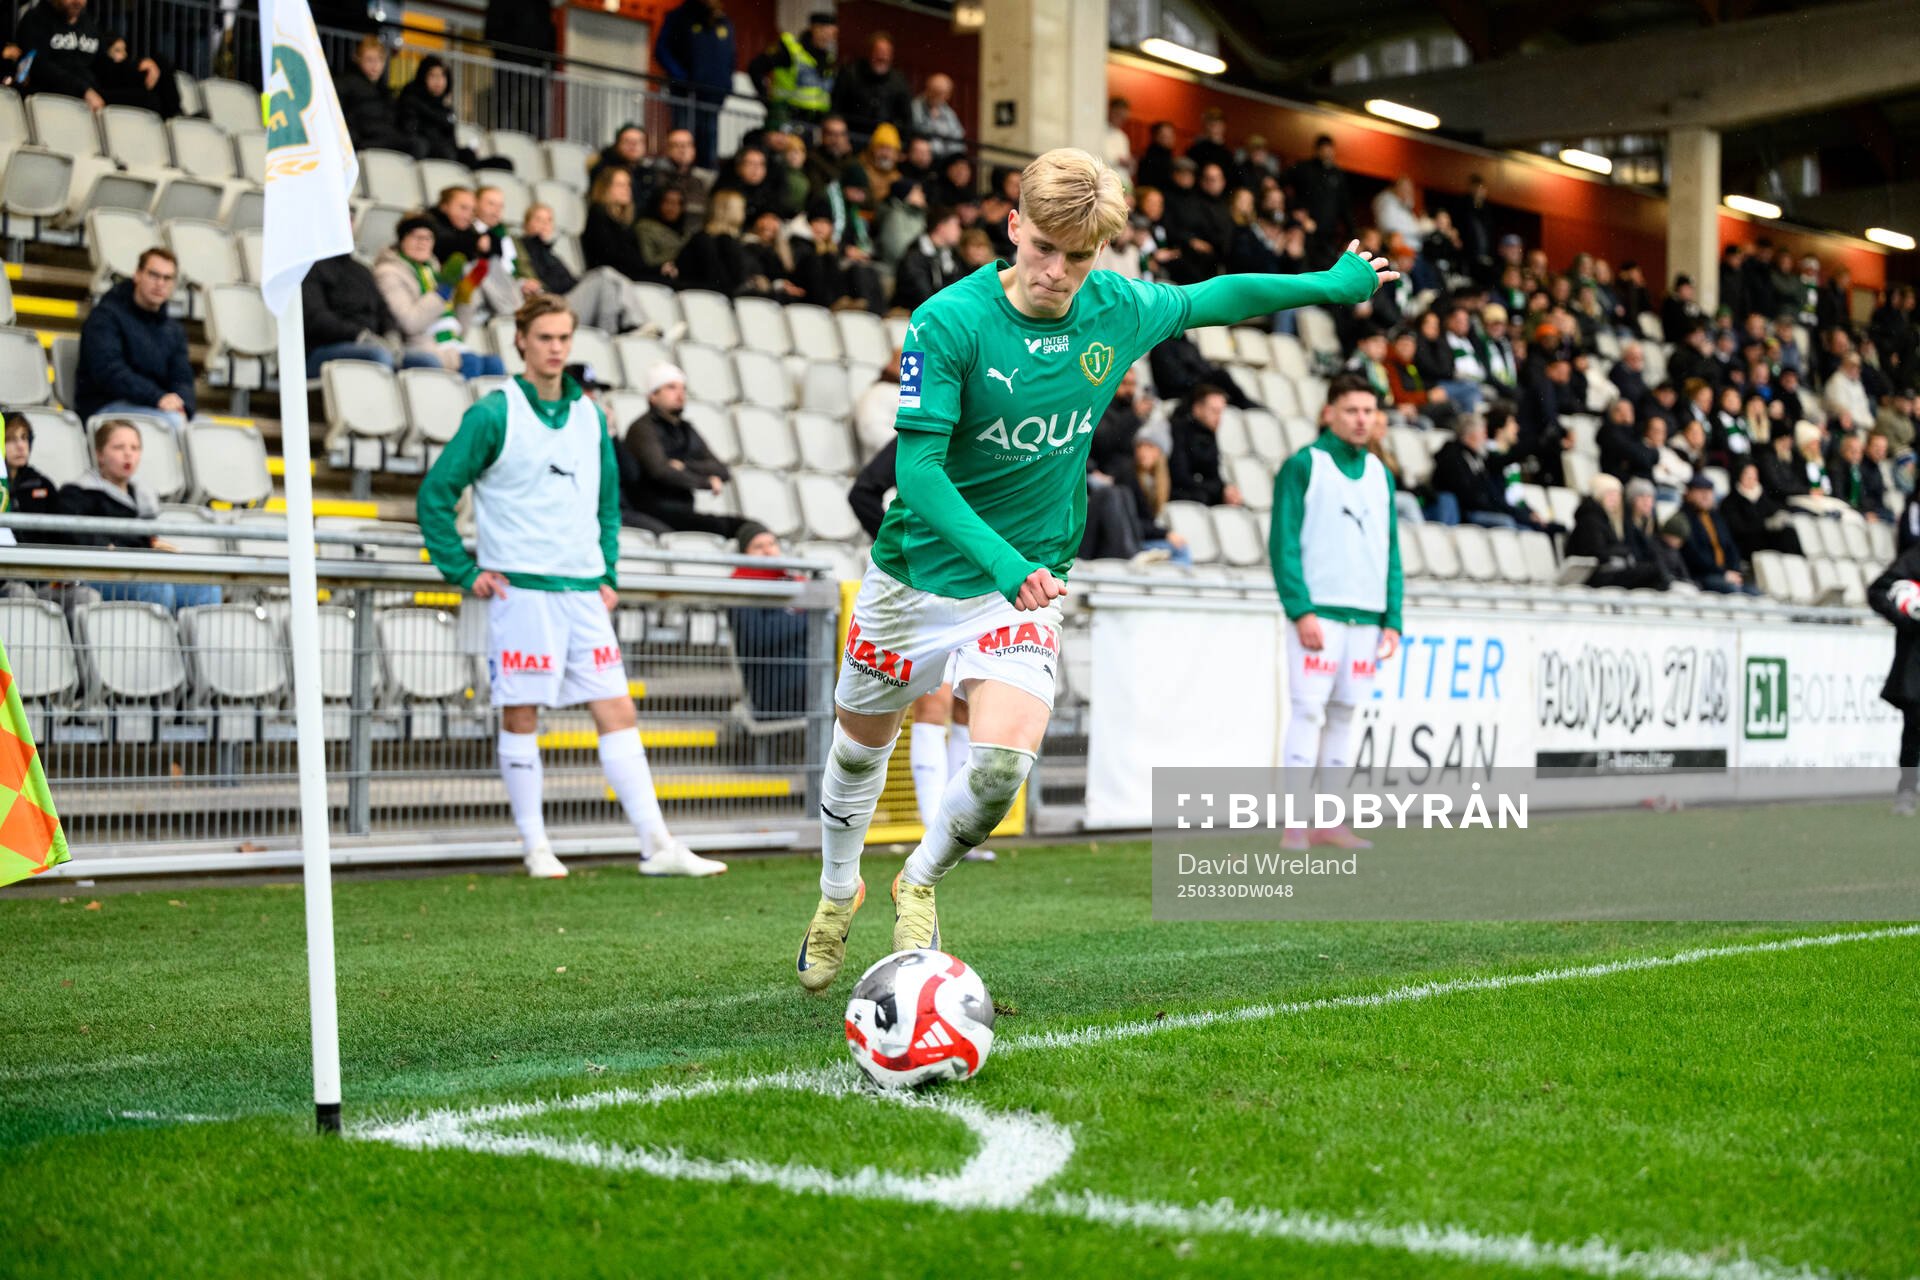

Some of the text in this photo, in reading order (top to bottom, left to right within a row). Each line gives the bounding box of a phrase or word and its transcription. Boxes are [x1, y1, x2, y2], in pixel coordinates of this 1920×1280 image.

[1043, 335, 1069, 346] INTER
[1043, 343, 1069, 354] SPORT
[994, 453, 1032, 463] DINNER
[846, 613, 913, 682] MAXI
[1372, 636, 1505, 699] TTER
[1347, 709, 1499, 789] ÄLSAN
